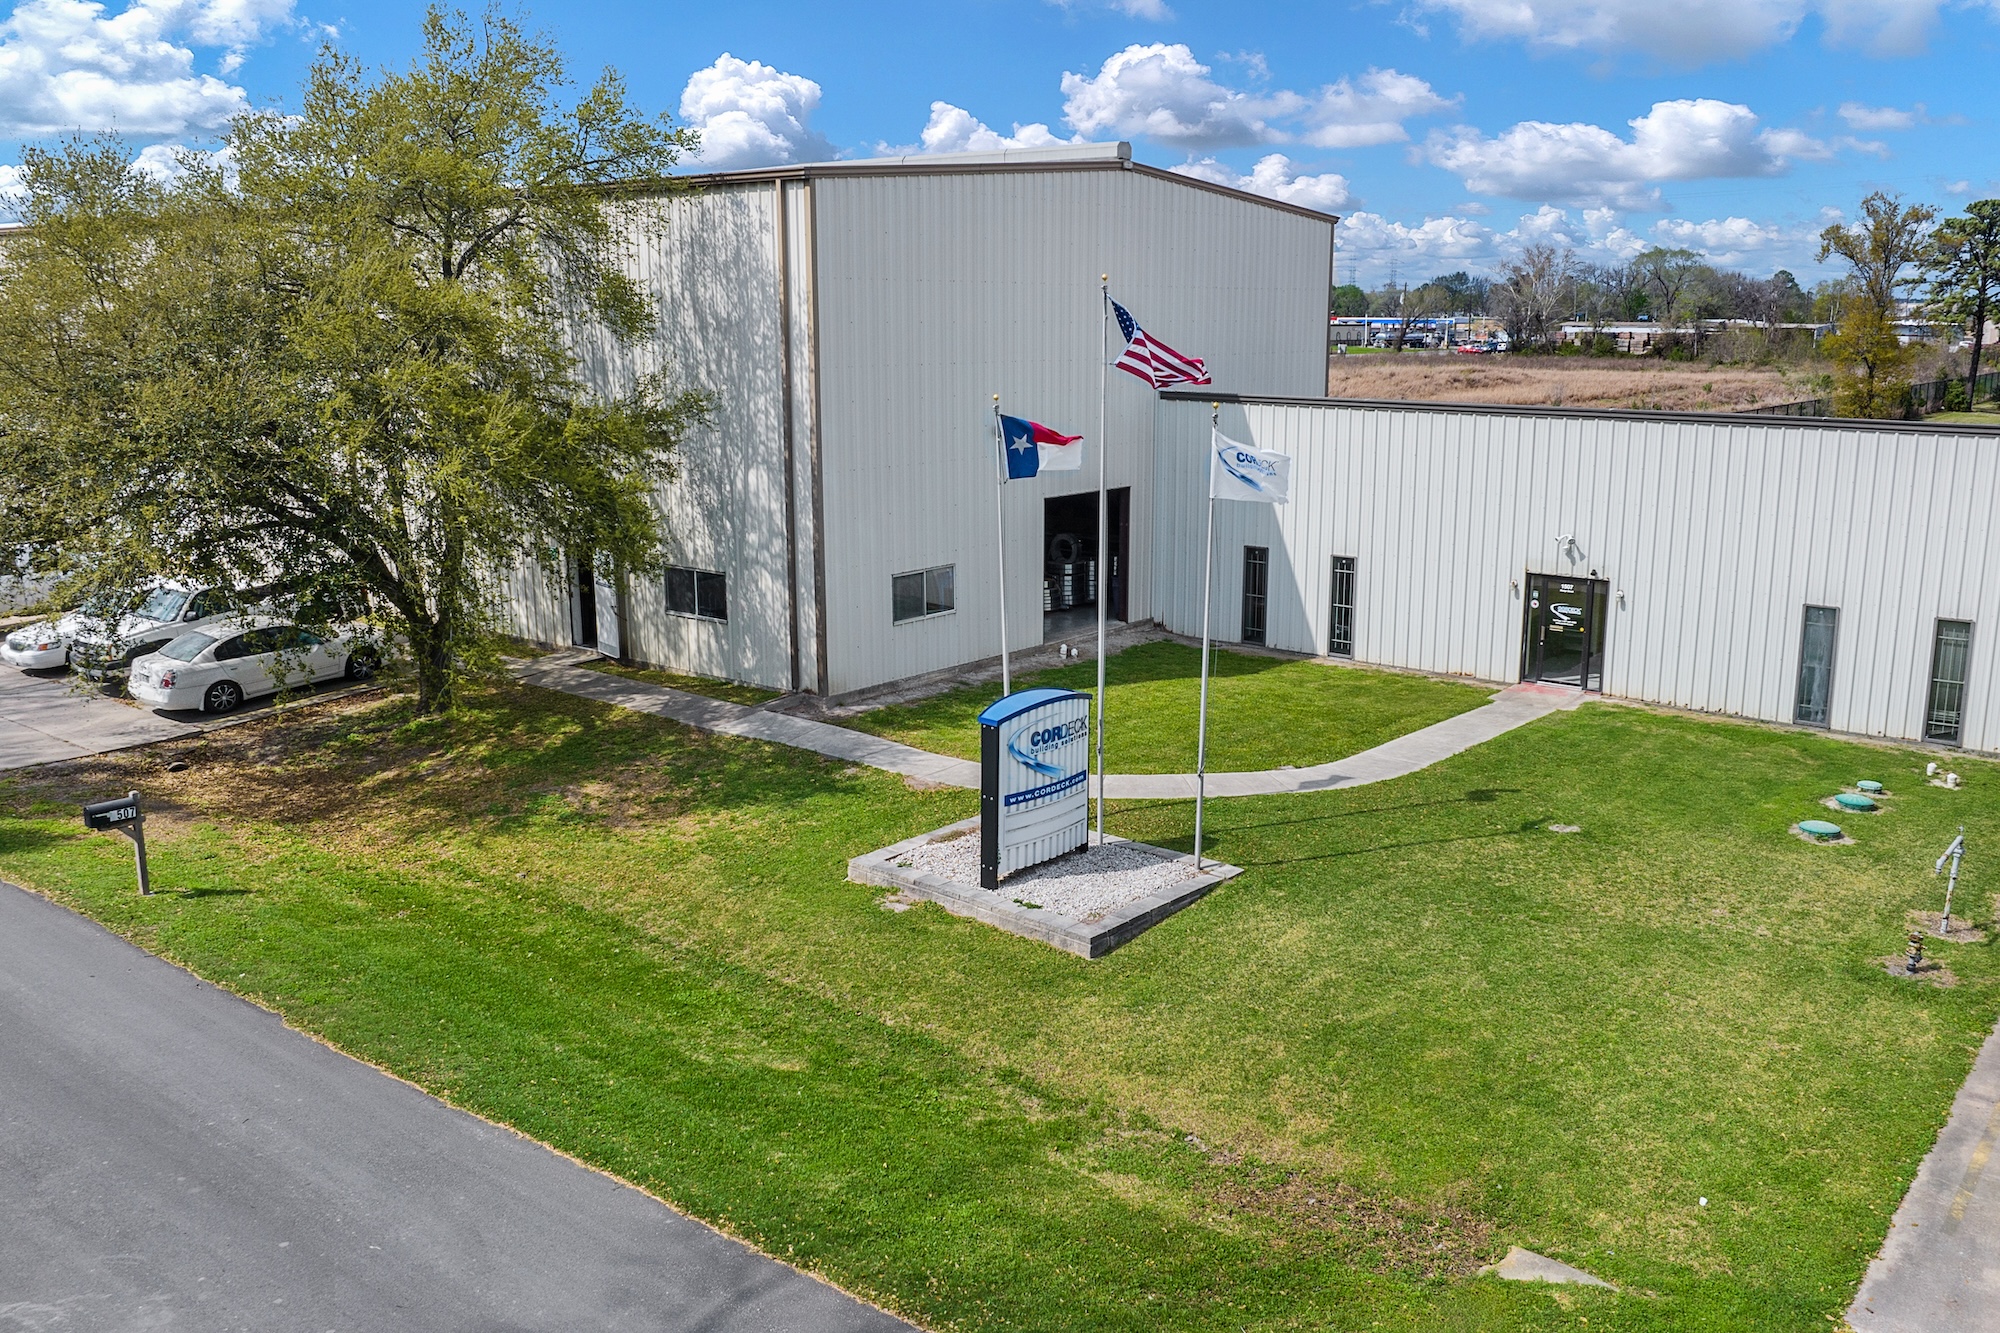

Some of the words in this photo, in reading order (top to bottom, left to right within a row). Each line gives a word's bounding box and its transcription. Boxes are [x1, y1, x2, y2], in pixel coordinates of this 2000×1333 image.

[1030, 714, 1088, 747] CORDECK
[1030, 741, 1059, 755] building
[1061, 731, 1088, 746] solutions
[1009, 774, 1085, 804] www.CORDECK.com
[116, 807, 135, 820] 507
